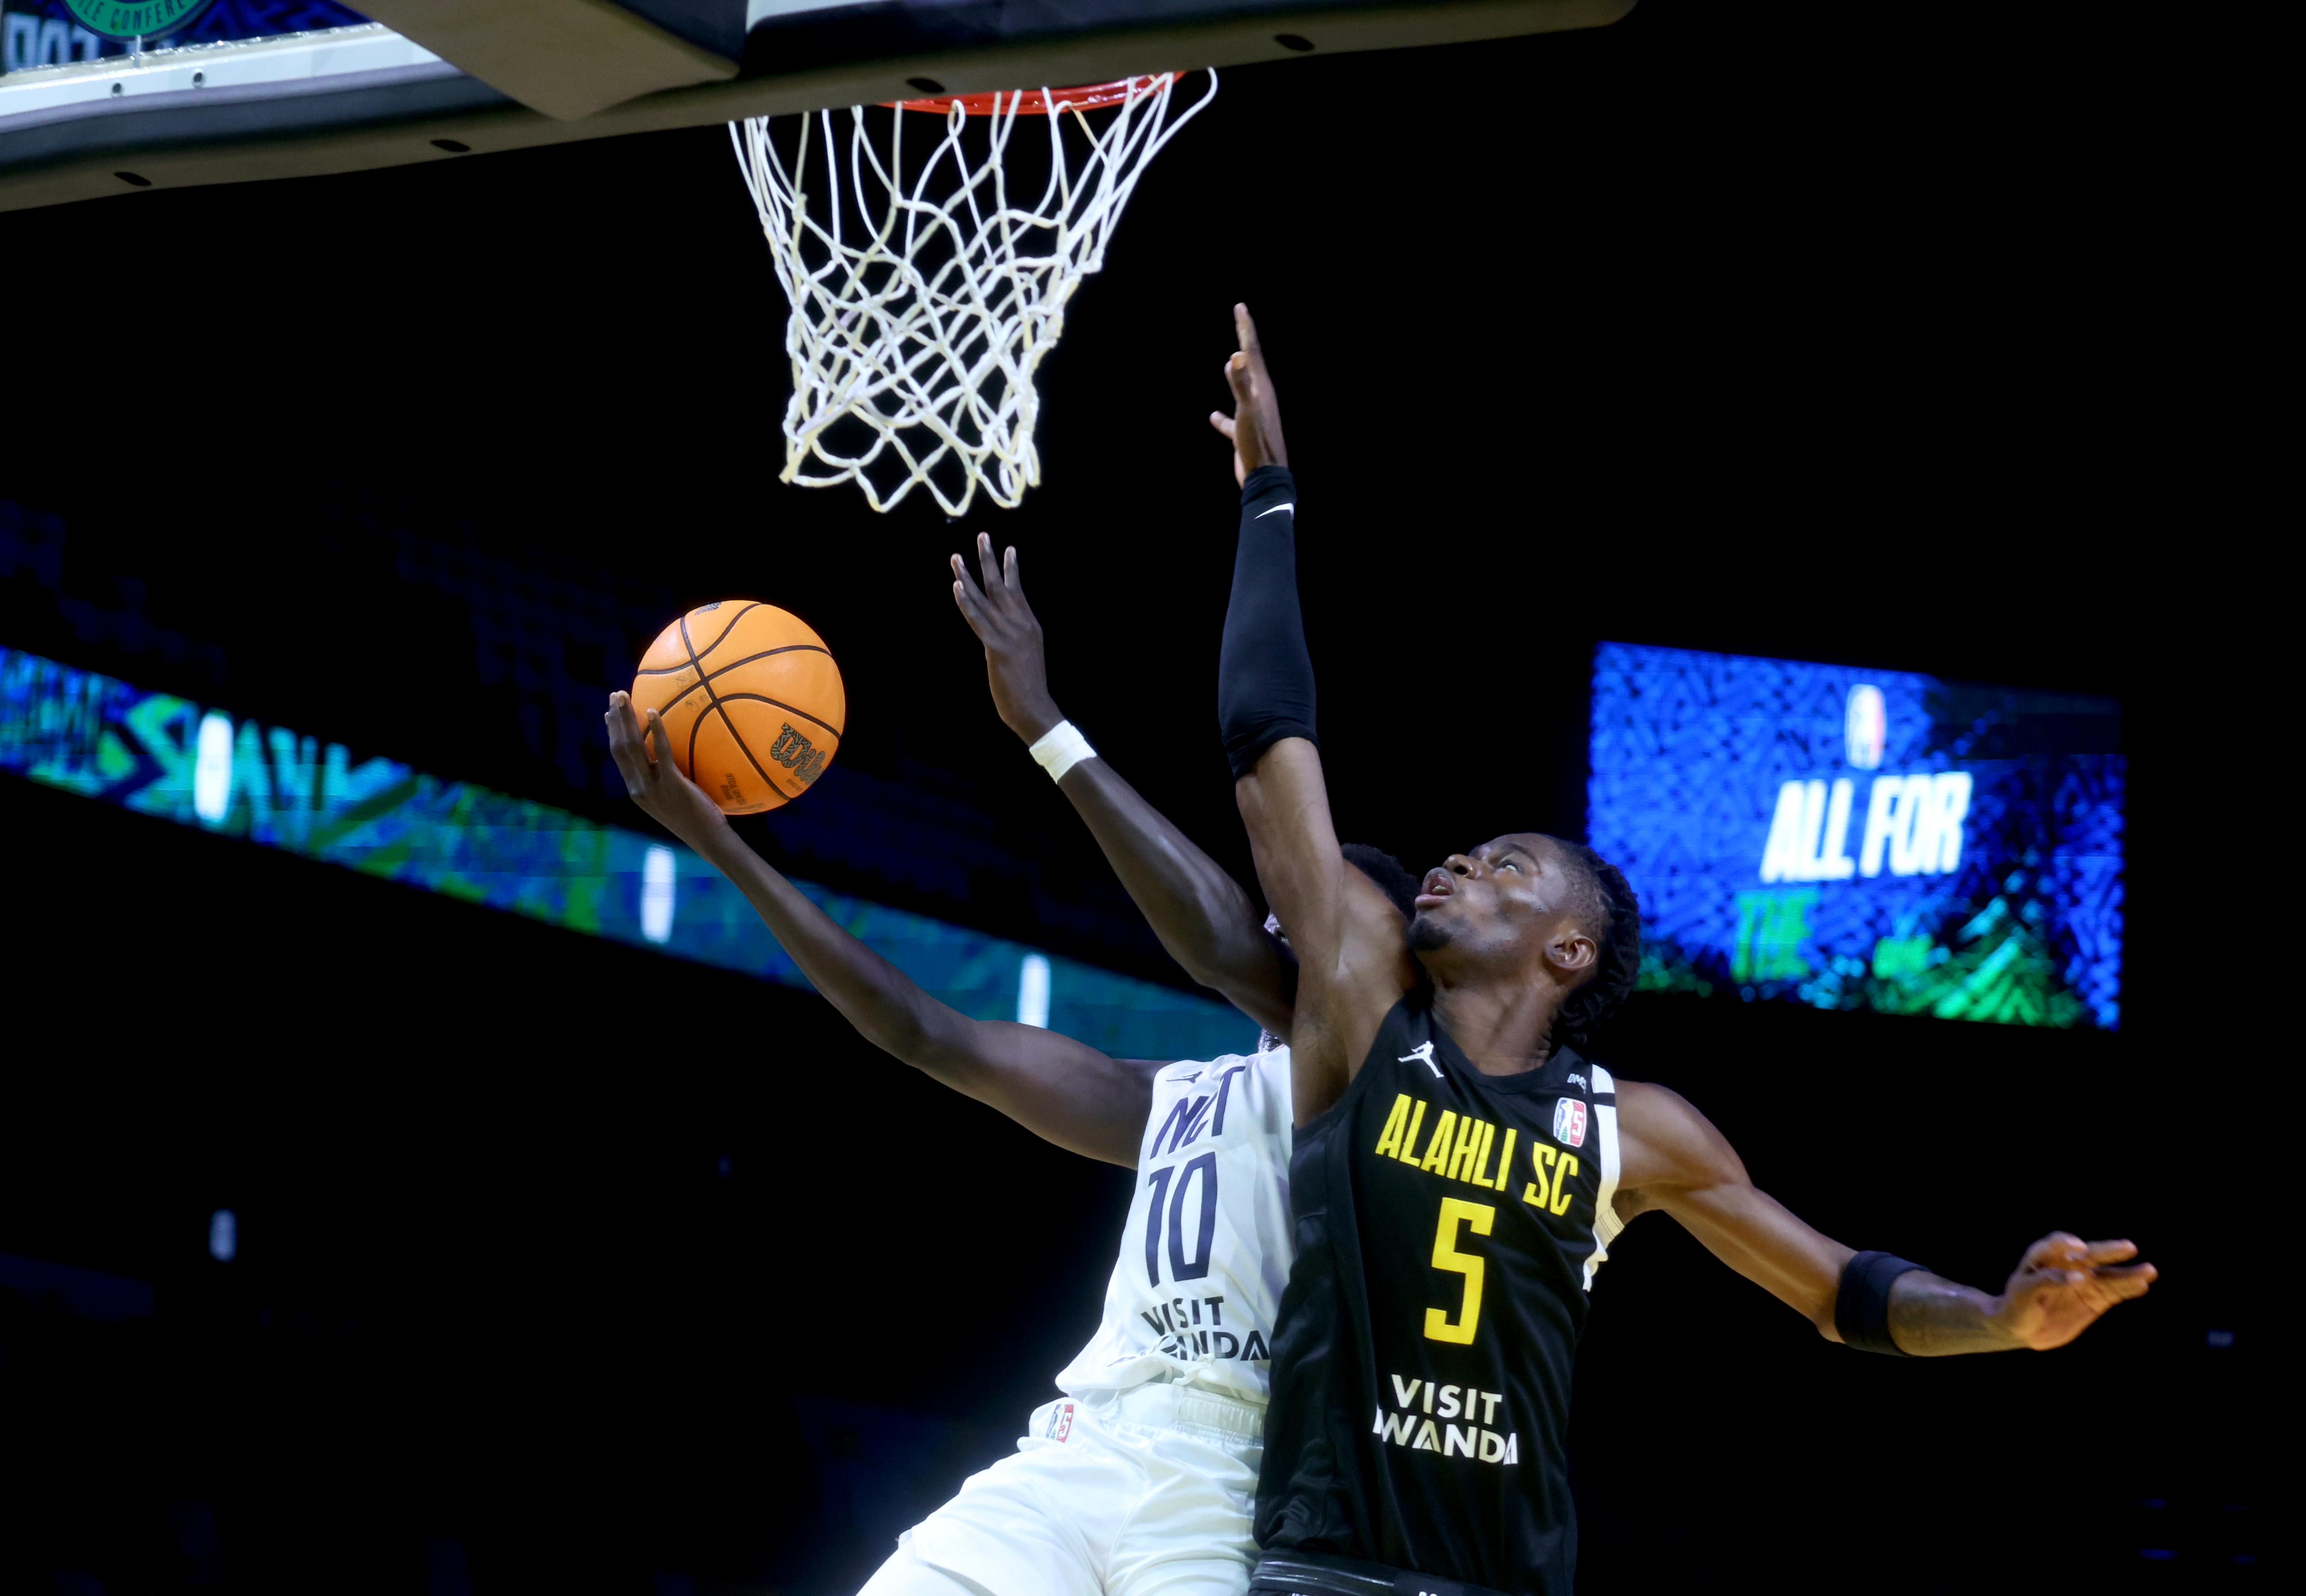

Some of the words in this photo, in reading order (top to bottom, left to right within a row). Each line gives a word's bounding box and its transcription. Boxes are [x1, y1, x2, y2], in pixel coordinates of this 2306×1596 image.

[771, 722, 825, 785] Wil
[1759, 779, 1856, 884] ALL
[1858, 772, 1974, 878] FOR
[1375, 1093, 1517, 1192] ALAHLI
[1522, 1141, 1579, 1216] SC
[1145, 1152, 1218, 1289] 10
[1424, 1197, 1495, 1345] 5
[1126, 1330, 1271, 1364] ANDA
[1140, 1296, 1224, 1337] VISIT
[1391, 1374, 1503, 1425] VISIT
